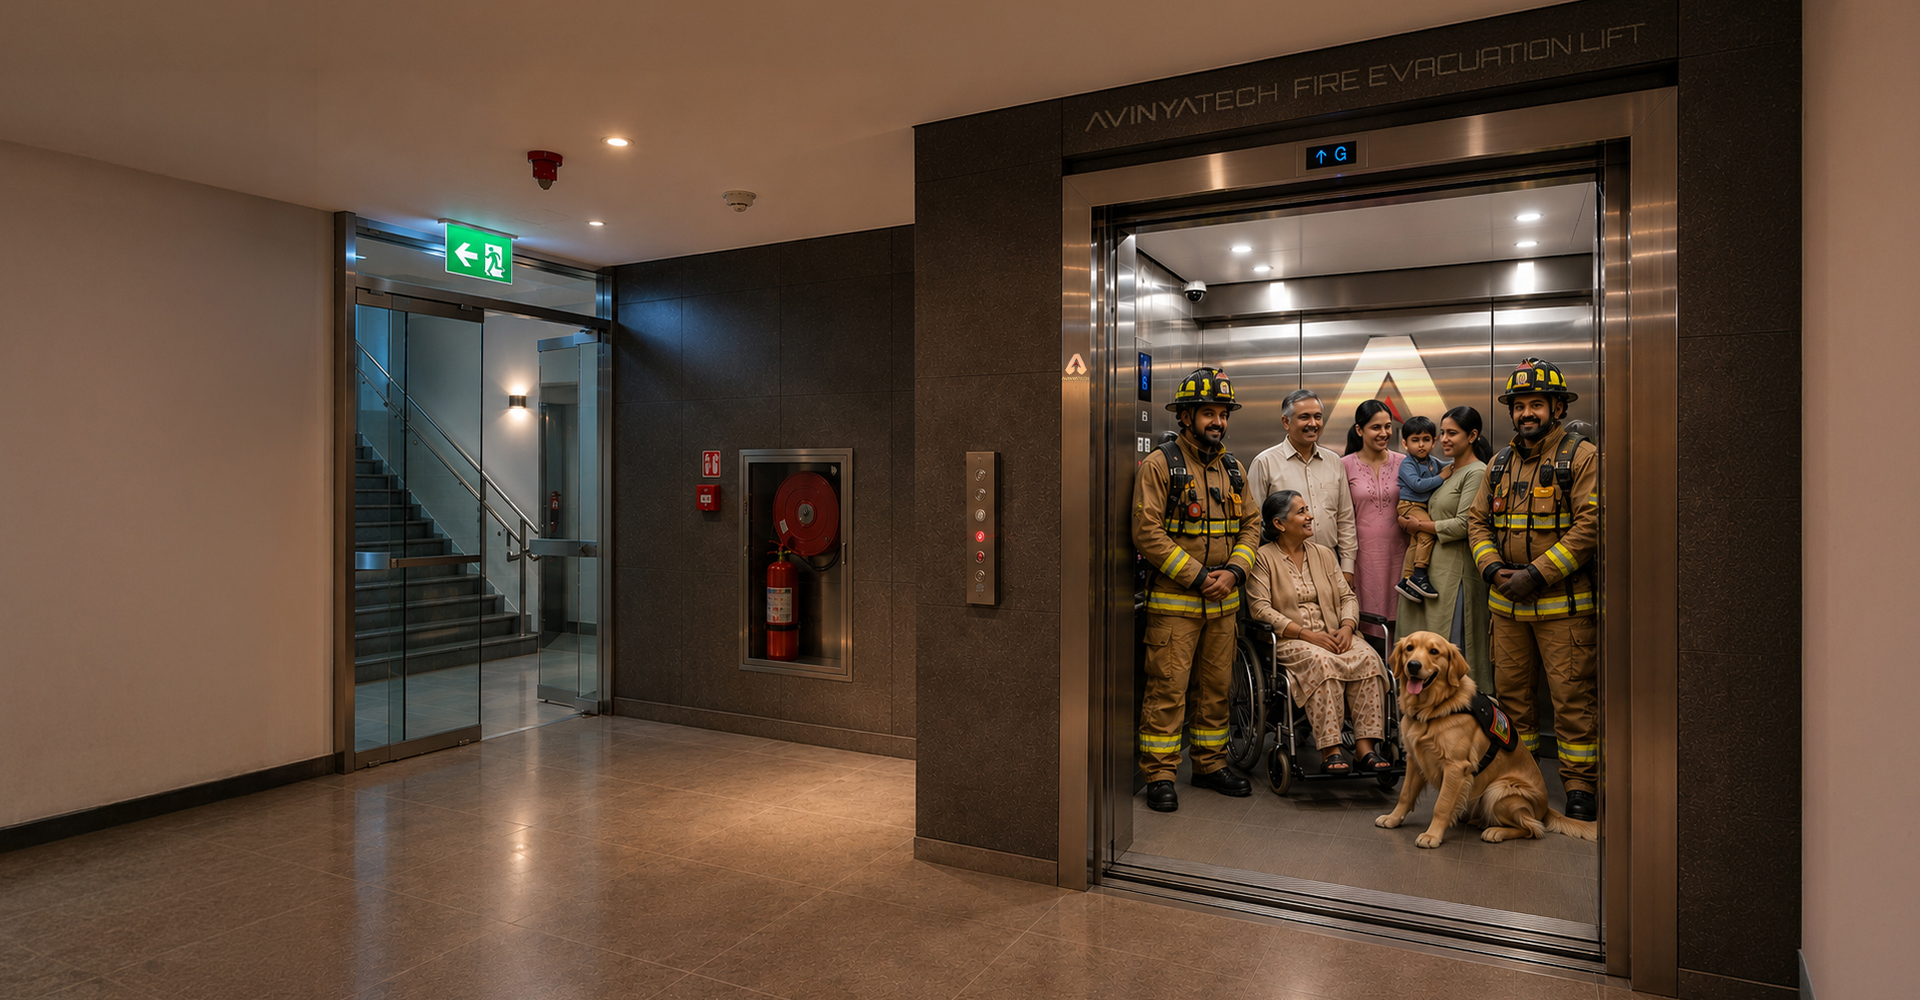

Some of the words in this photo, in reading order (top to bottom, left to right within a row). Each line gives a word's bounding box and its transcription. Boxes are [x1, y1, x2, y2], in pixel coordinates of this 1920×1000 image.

[1085, 83, 1278, 132] AVINYATECH
[1294, 69, 1360, 99] FIRE
[1369, 34, 1572, 87] EVACUATION
[1580, 22, 1645, 53] LIFT
[1334, 146, 1347, 161] G
